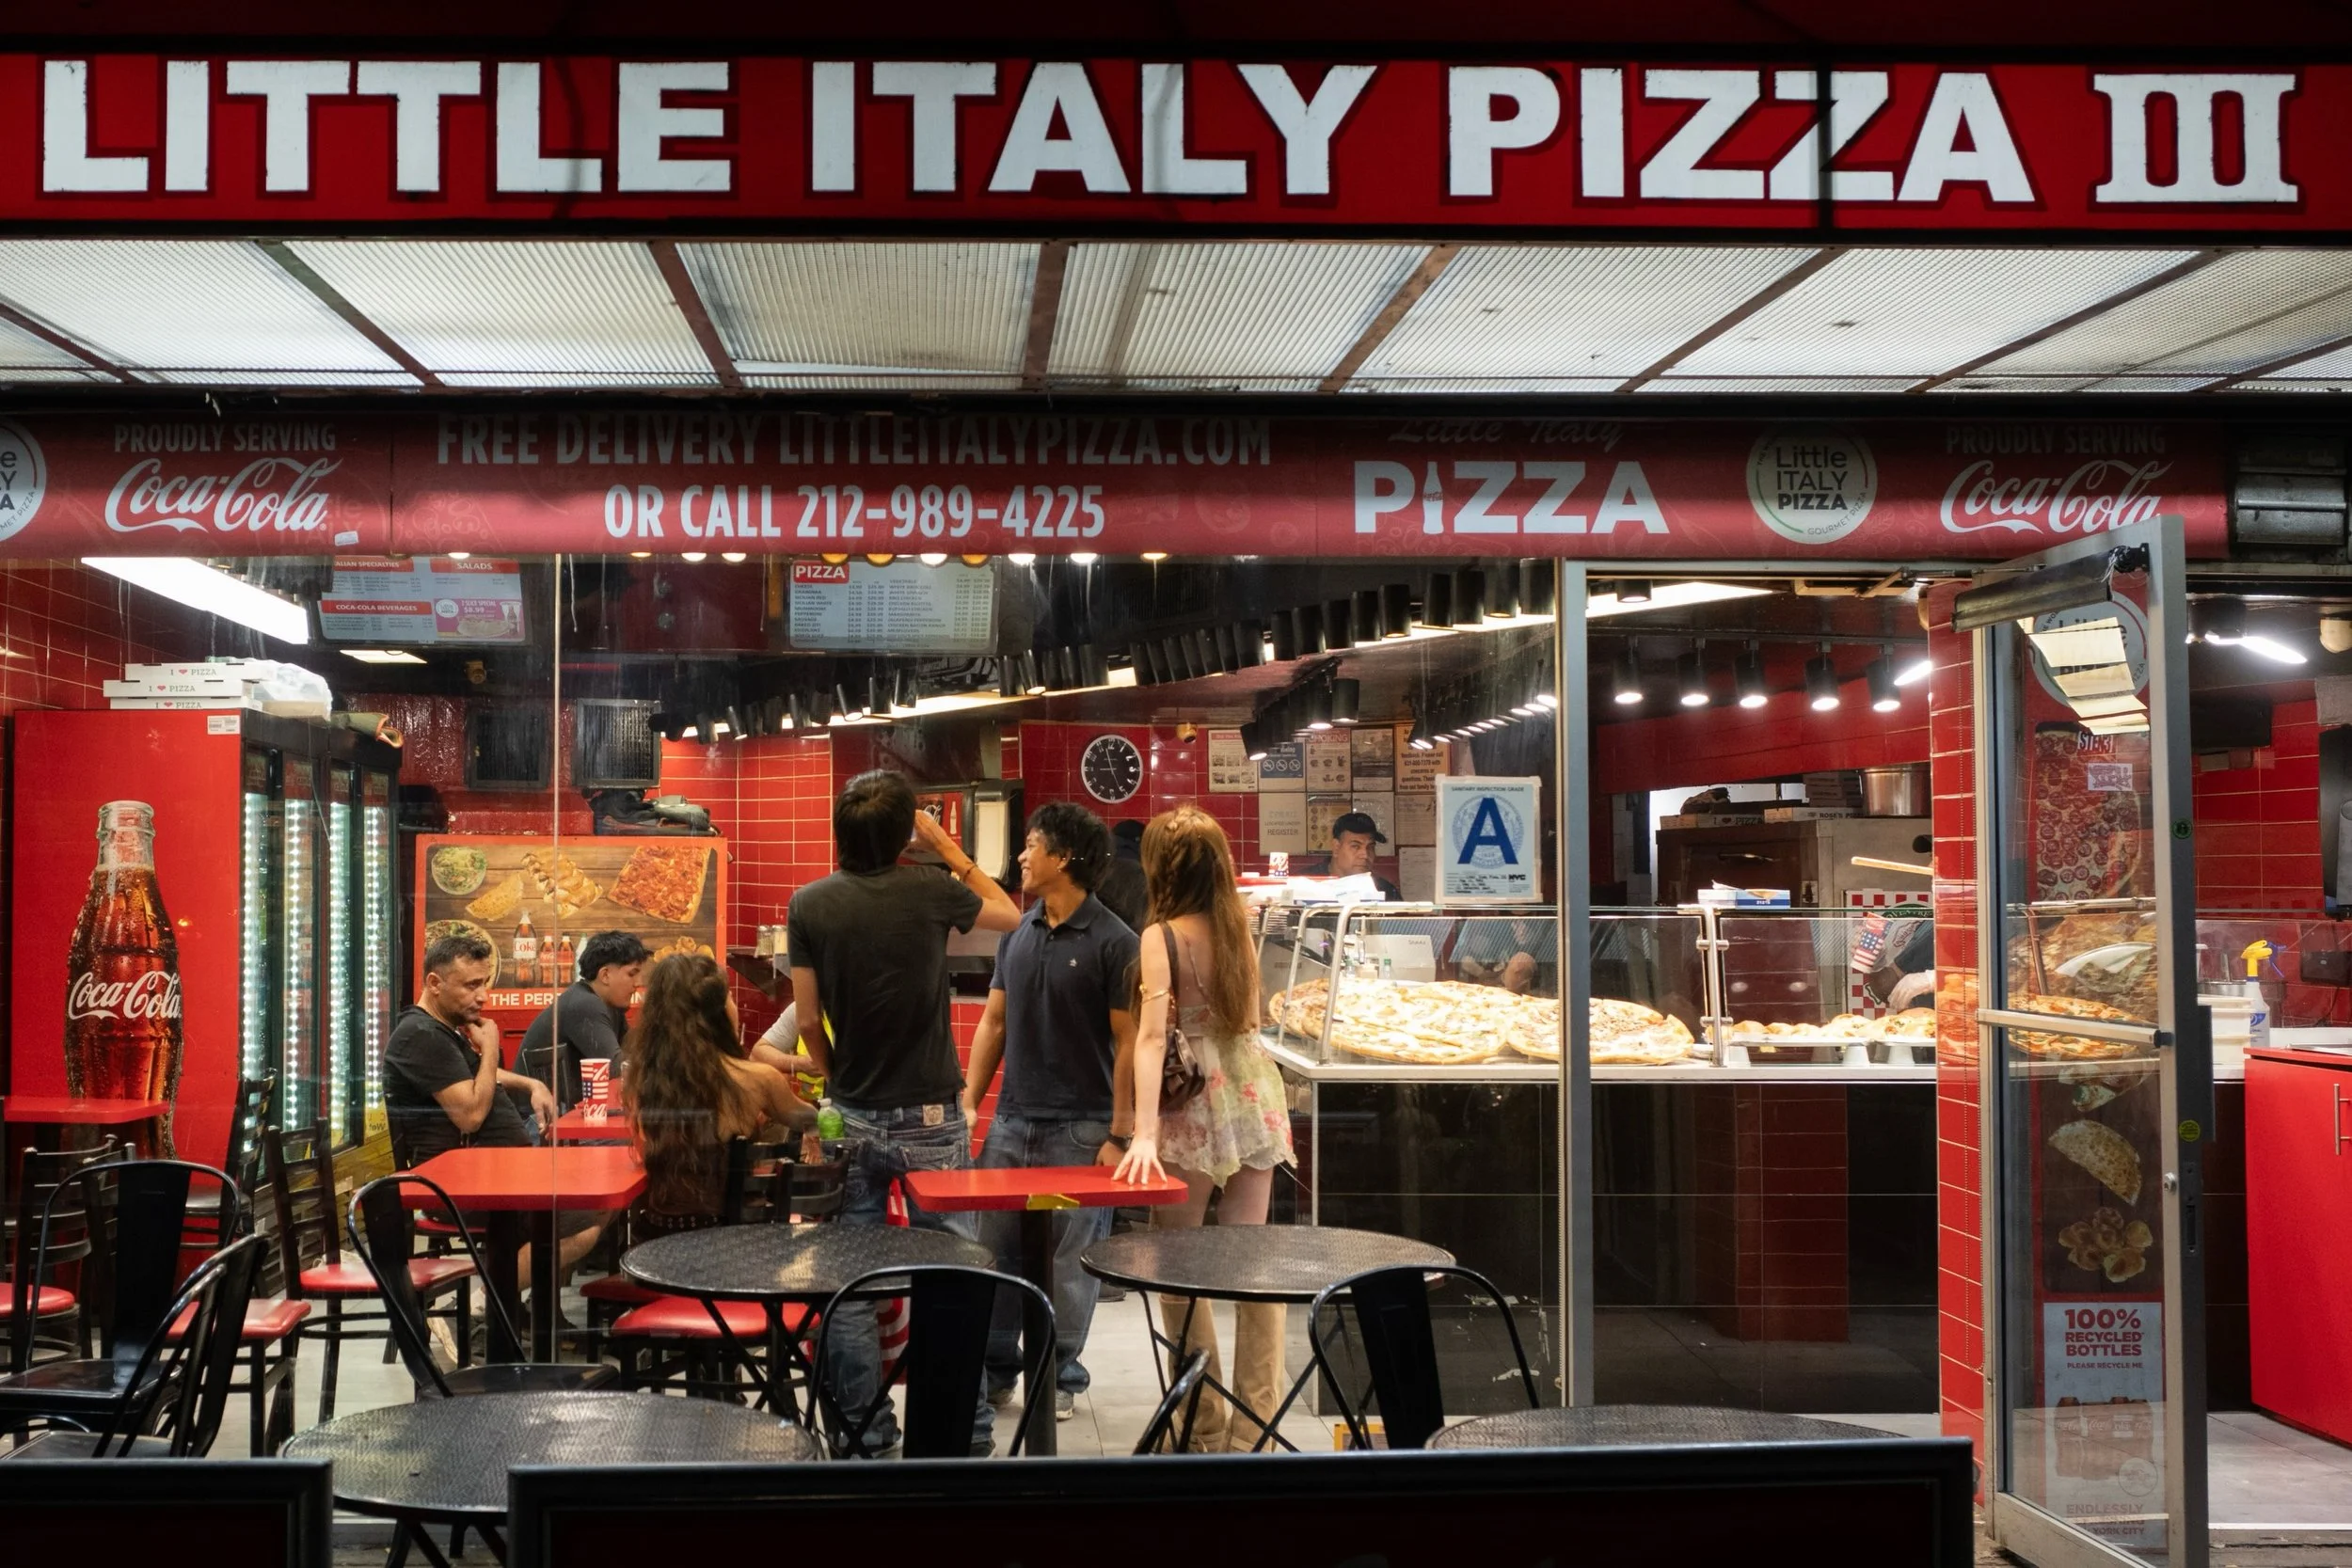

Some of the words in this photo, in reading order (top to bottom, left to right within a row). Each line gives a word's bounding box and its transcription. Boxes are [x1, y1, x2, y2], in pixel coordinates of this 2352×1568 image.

[43, 60, 731, 192] LITTLE
[812, 61, 1377, 196] ITALY
[1449, 66, 2035, 202] PIZZA
[2093, 73, 2298, 203] III
[115, 423, 224, 453] PROUDLY
[233, 423, 337, 452] SERVING
[437, 413, 539, 465] FREE
[556, 413, 764, 465] DELIVERY
[780, 415, 1271, 465] LITTLEITALYPIZZA.COM
[1389, 419, 1503, 444] Little
[1522, 419, 1627, 453] Italy
[1947, 425, 2054, 454] PROUDLY
[2064, 425, 2166, 454] SERVING
[1776, 445, 1848, 468] Little
[1777, 470, 1849, 491] ITALY
[104, 457, 344, 534] Coca-Cola
[1355, 460, 1671, 535] PIZZA
[1778, 493, 1848, 511] PIZZA
[1939, 458, 2175, 534] Coca-Cola
[605, 484, 664, 539] OR
[679, 484, 782, 539] CALL
[796, 484, 1105, 539] 212-989-4225
[1807, 515, 1851, 535] GOURMET
[1850, 491, 1867, 516] PIZZA
[795, 565, 846, 578] PIZZA
[1456, 797, 1519, 864] A
[68, 970, 183, 1021] Coca-Cola
[489, 993, 520, 1006] THE
[2064, 1308, 2141, 1329] 100%
[2065, 1331, 2143, 1343] RECYCLED
[2066, 1344, 2142, 1356] BOTTLES
[2067, 1504, 2144, 1515] ENDLESSLY
[2122, 1527, 2146, 1536] CITY
